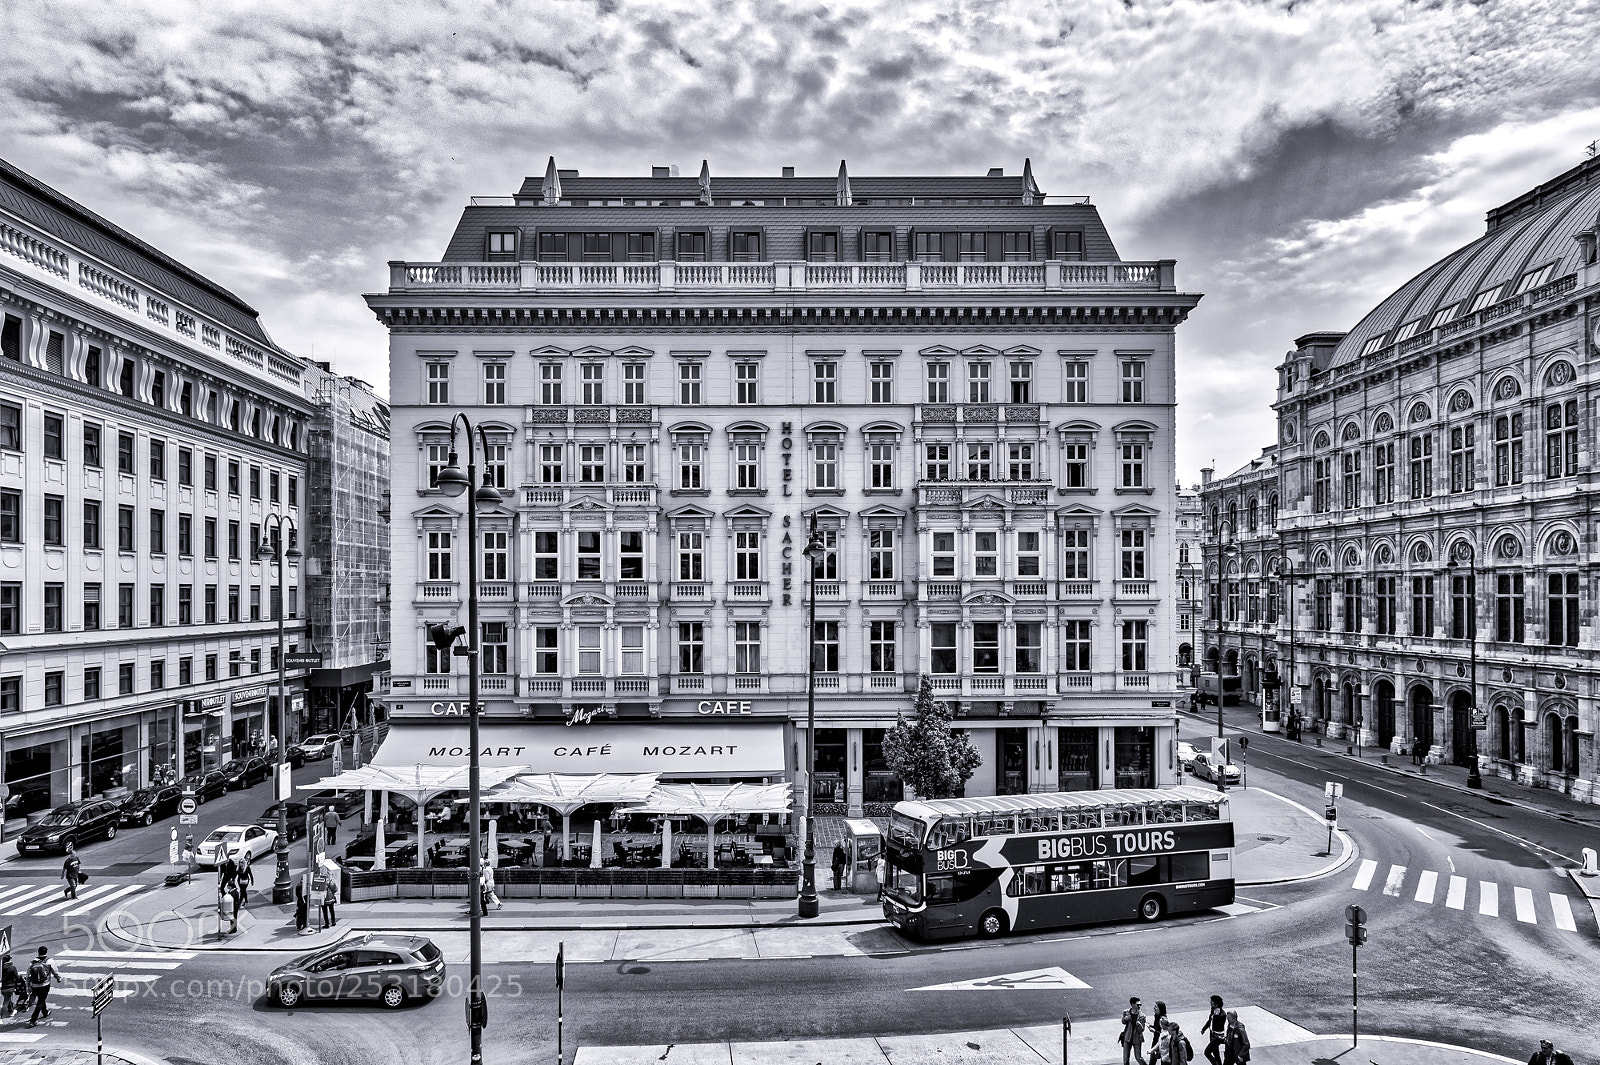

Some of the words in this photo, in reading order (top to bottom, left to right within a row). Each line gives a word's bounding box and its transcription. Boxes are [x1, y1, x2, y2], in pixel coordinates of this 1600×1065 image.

[781, 421, 793, 498] HOTEL
[781, 514, 793, 607] SACHER
[431, 702, 486, 715] CAFE
[565, 703, 606, 727] Mozart
[697, 701, 752, 715] CAFE
[553, 743, 612, 757] CAFÉ
[642, 745, 738, 756] MOZART
[1112, 830, 1176, 854] TOURS
[937, 850, 955, 861] BIG
[937, 860, 955, 871] BUS
